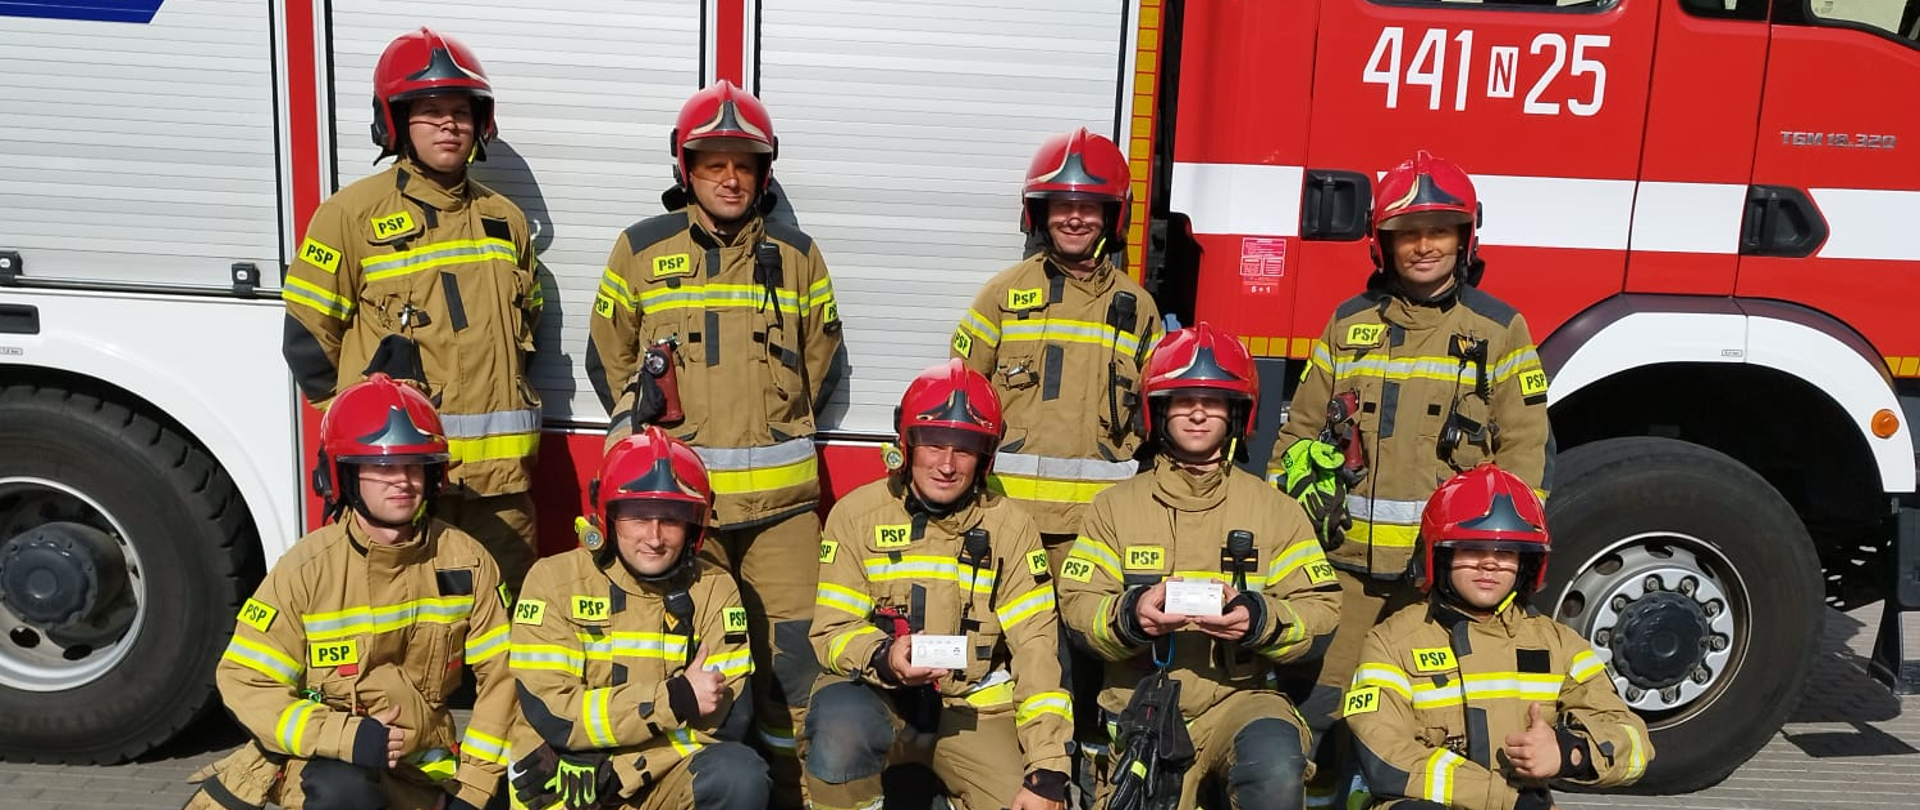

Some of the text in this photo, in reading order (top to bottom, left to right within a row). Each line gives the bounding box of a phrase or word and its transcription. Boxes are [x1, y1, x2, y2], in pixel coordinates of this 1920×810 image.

[1362, 27, 1612, 116] 441 N 25
[1780, 131, 1824, 146] TGM
[378, 216, 405, 234] PSP
[306, 244, 334, 264] PSP
[659, 257, 685, 272] PSP
[597, 297, 609, 313] SP
[1013, 292, 1037, 305] PSP
[881, 529, 906, 543] PSP
[820, 544, 832, 558] SP
[1131, 550, 1159, 565] PSP
[1032, 553, 1047, 569] PS
[1063, 561, 1089, 577] PSP
[246, 603, 267, 622] PSP
[516, 603, 540, 619] PSP
[579, 600, 604, 615] PSP
[318, 645, 351, 662] PSP
[1419, 652, 1447, 667] PSP
[1349, 692, 1373, 710] PSP
